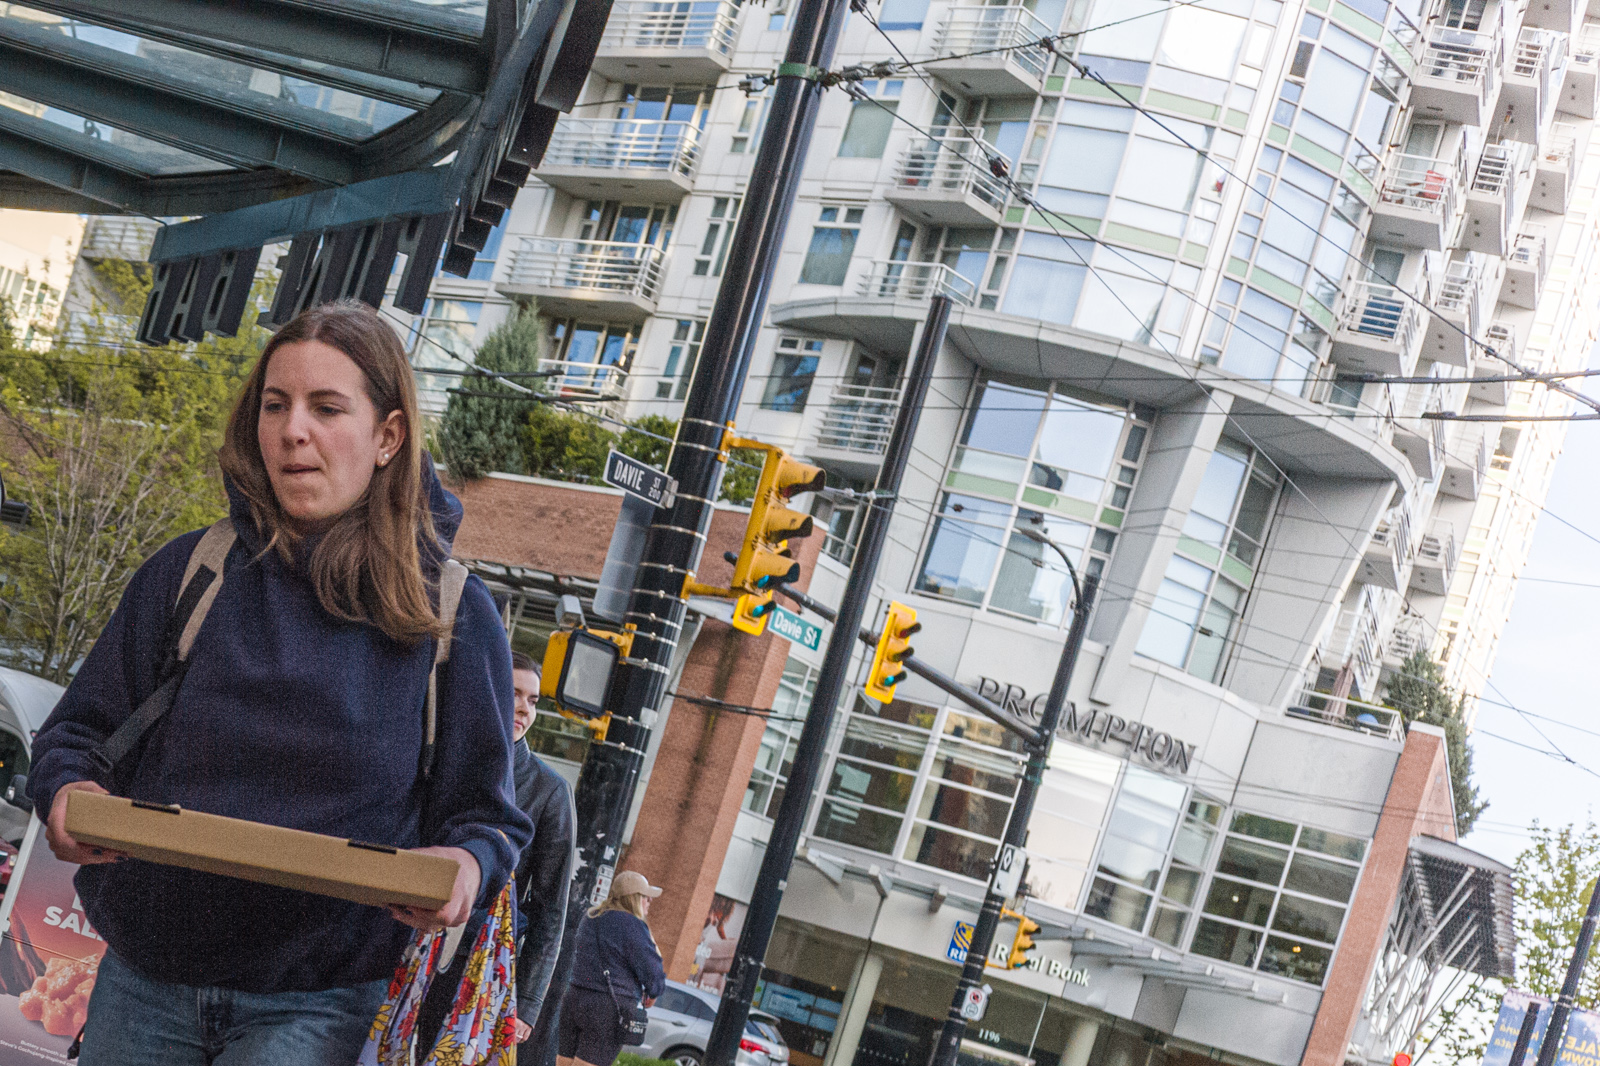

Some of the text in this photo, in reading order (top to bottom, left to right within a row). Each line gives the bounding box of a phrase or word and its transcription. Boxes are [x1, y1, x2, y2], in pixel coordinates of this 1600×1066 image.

[613, 460, 662, 491] DAVIE ST
[774, 612, 818, 647] Davie St
[1048, 959, 1091, 987] Bank
[979, 1028, 1000, 1043] 1196
